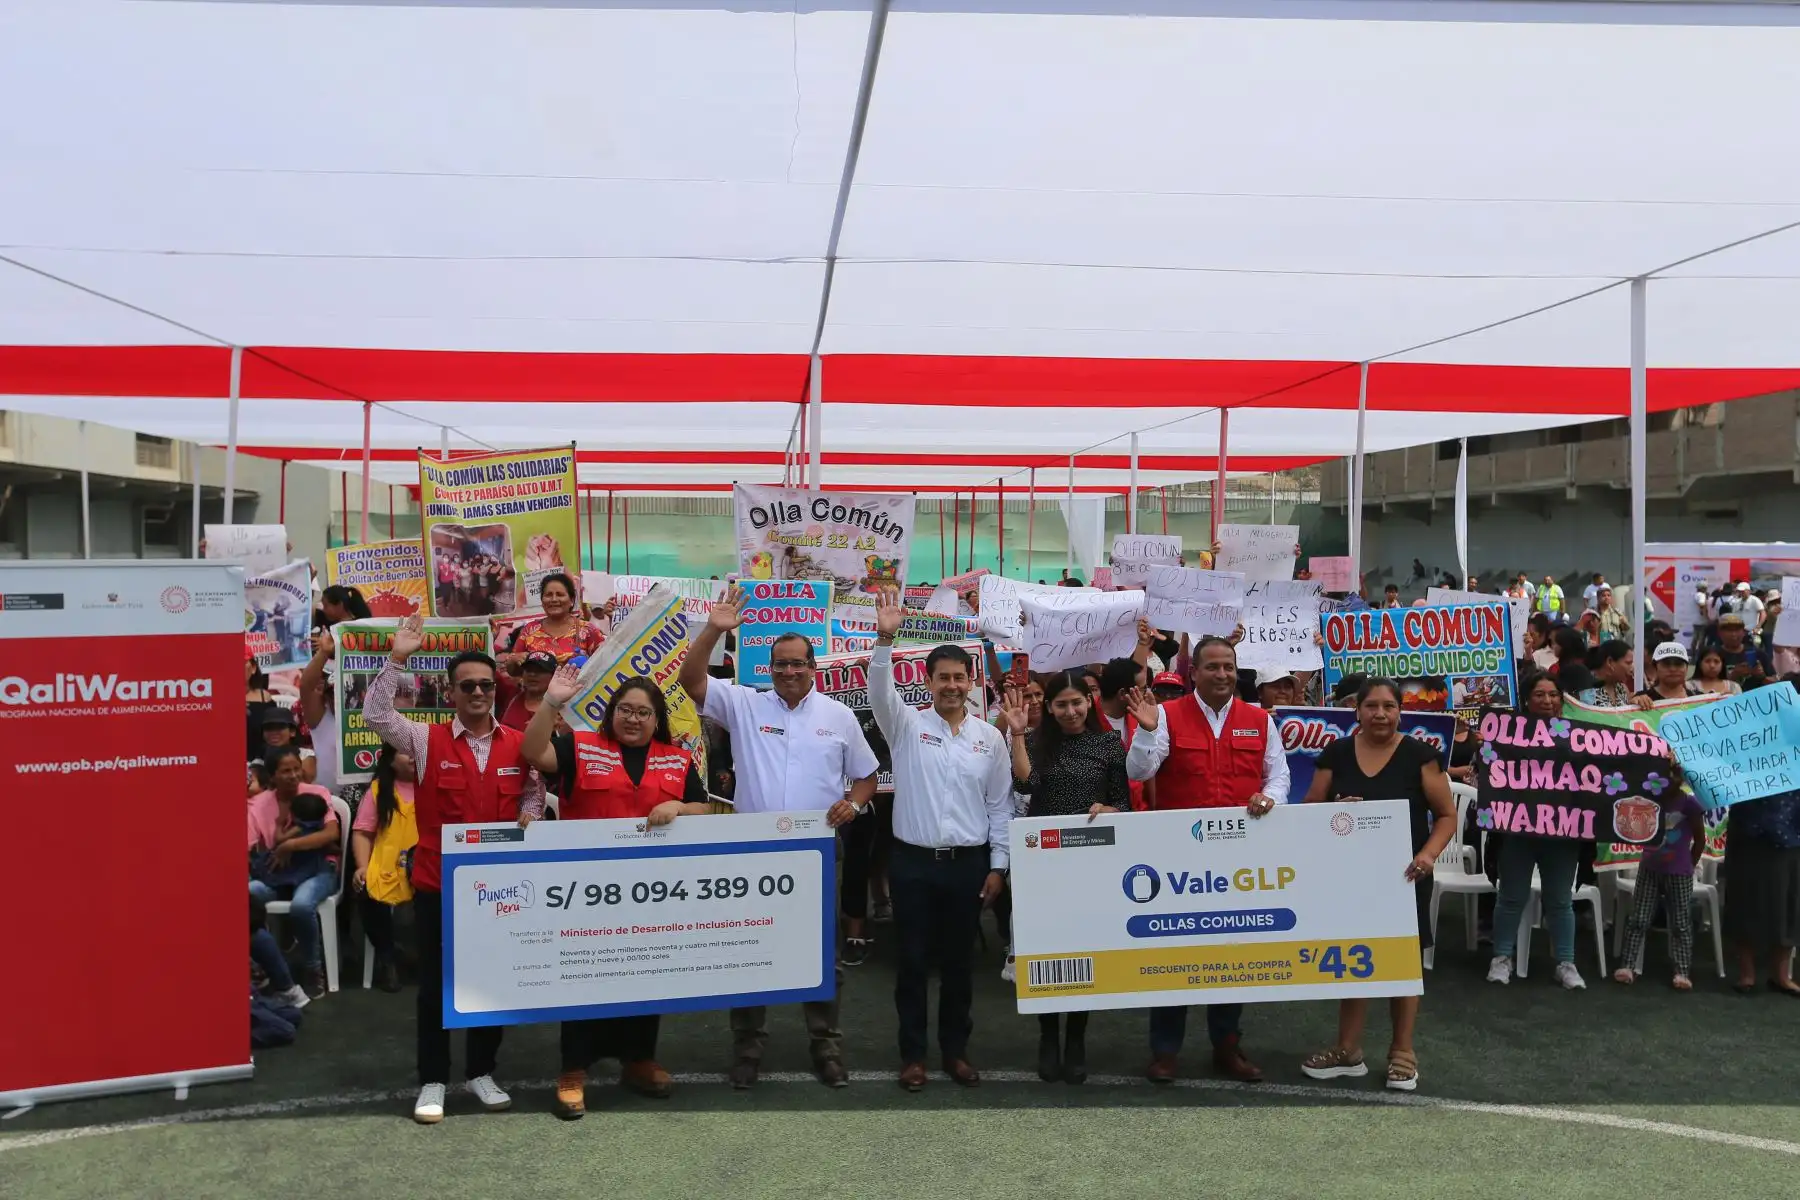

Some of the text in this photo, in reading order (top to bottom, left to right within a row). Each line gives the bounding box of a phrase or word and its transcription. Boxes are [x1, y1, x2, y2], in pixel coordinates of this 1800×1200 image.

[446, 456, 572, 486] COMÚN LAS SOLIDARIAS"
[466, 491, 471, 501] 2
[474, 486, 514, 500] PARAÍSO
[517, 482, 539, 496] ALTO
[527, 495, 572, 512] VENCIDAS!
[750, 498, 903, 544] Olla Común
[827, 535, 848, 548] 22
[854, 536, 876, 550] A2
[338, 544, 418, 562] Bienvenidos
[339, 554, 423, 575] La Olla comú
[1112, 563, 1122, 575] 8
[374, 573, 385, 582] de
[386, 572, 406, 582] Buen
[408, 569, 423, 580] Sab
[255, 578, 308, 604] TRIUNFADORES
[754, 583, 816, 599] OLLA
[742, 608, 825, 624] COMUN
[916, 619, 927, 630] ES
[1326, 612, 1399, 652] OLLA
[1403, 606, 1504, 647] COMUN
[422, 628, 486, 652] OMÚN
[744, 637, 762, 646] LAS
[1658, 648, 1684, 656] adidas
[816, 666, 867, 692] LLA
[0, 673, 212, 705] QaliWarma
[0, 710, 47, 718] ROGRAMA
[50, 708, 95, 716] NACIONAL
[111, 704, 174, 714] ALIMENTACIÓN
[177, 703, 212, 712] ESCOLAR
[1662, 687, 1792, 742] OLLA COMUN
[1480, 712, 1555, 747] OLLA
[1571, 728, 1669, 757] COMUN
[1741, 733, 1760, 750] ES
[1763, 725, 1778, 744] MI
[15, 755, 197, 774] www.gob.pe/qaliwarma
[1684, 763, 1743, 787] PASTOR
[1749, 752, 1787, 772] NADA
[1489, 759, 1602, 793] SUMAQ
[1208, 819, 1245, 831] FISE
[1491, 801, 1595, 838] WARMI
[474, 881, 486, 890] Con
[546, 874, 794, 909] S/ 98 094 389 00
[478, 886, 519, 906] PUNCHE
[496, 901, 520, 916] Perú
[560, 927, 612, 937] Ministerio
[632, 923, 684, 934] Desarrollo
[696, 920, 741, 929] Inclusión
[744, 917, 774, 926] Social
[1149, 914, 1274, 931] OLLAS COMUNES
[595, 969, 635, 978] alimentaria
[636, 966, 694, 976] complementaria
[696, 964, 711, 972] para
[741, 960, 772, 968] comunes
[1140, 960, 1291, 974] DESCUENTO PARA LA COMPRA
[1188, 976, 1200, 984] DE
[1204, 974, 1217, 983] UN
[1221, 972, 1254, 982] BALÓN
[1273, 972, 1293, 980] GLP
